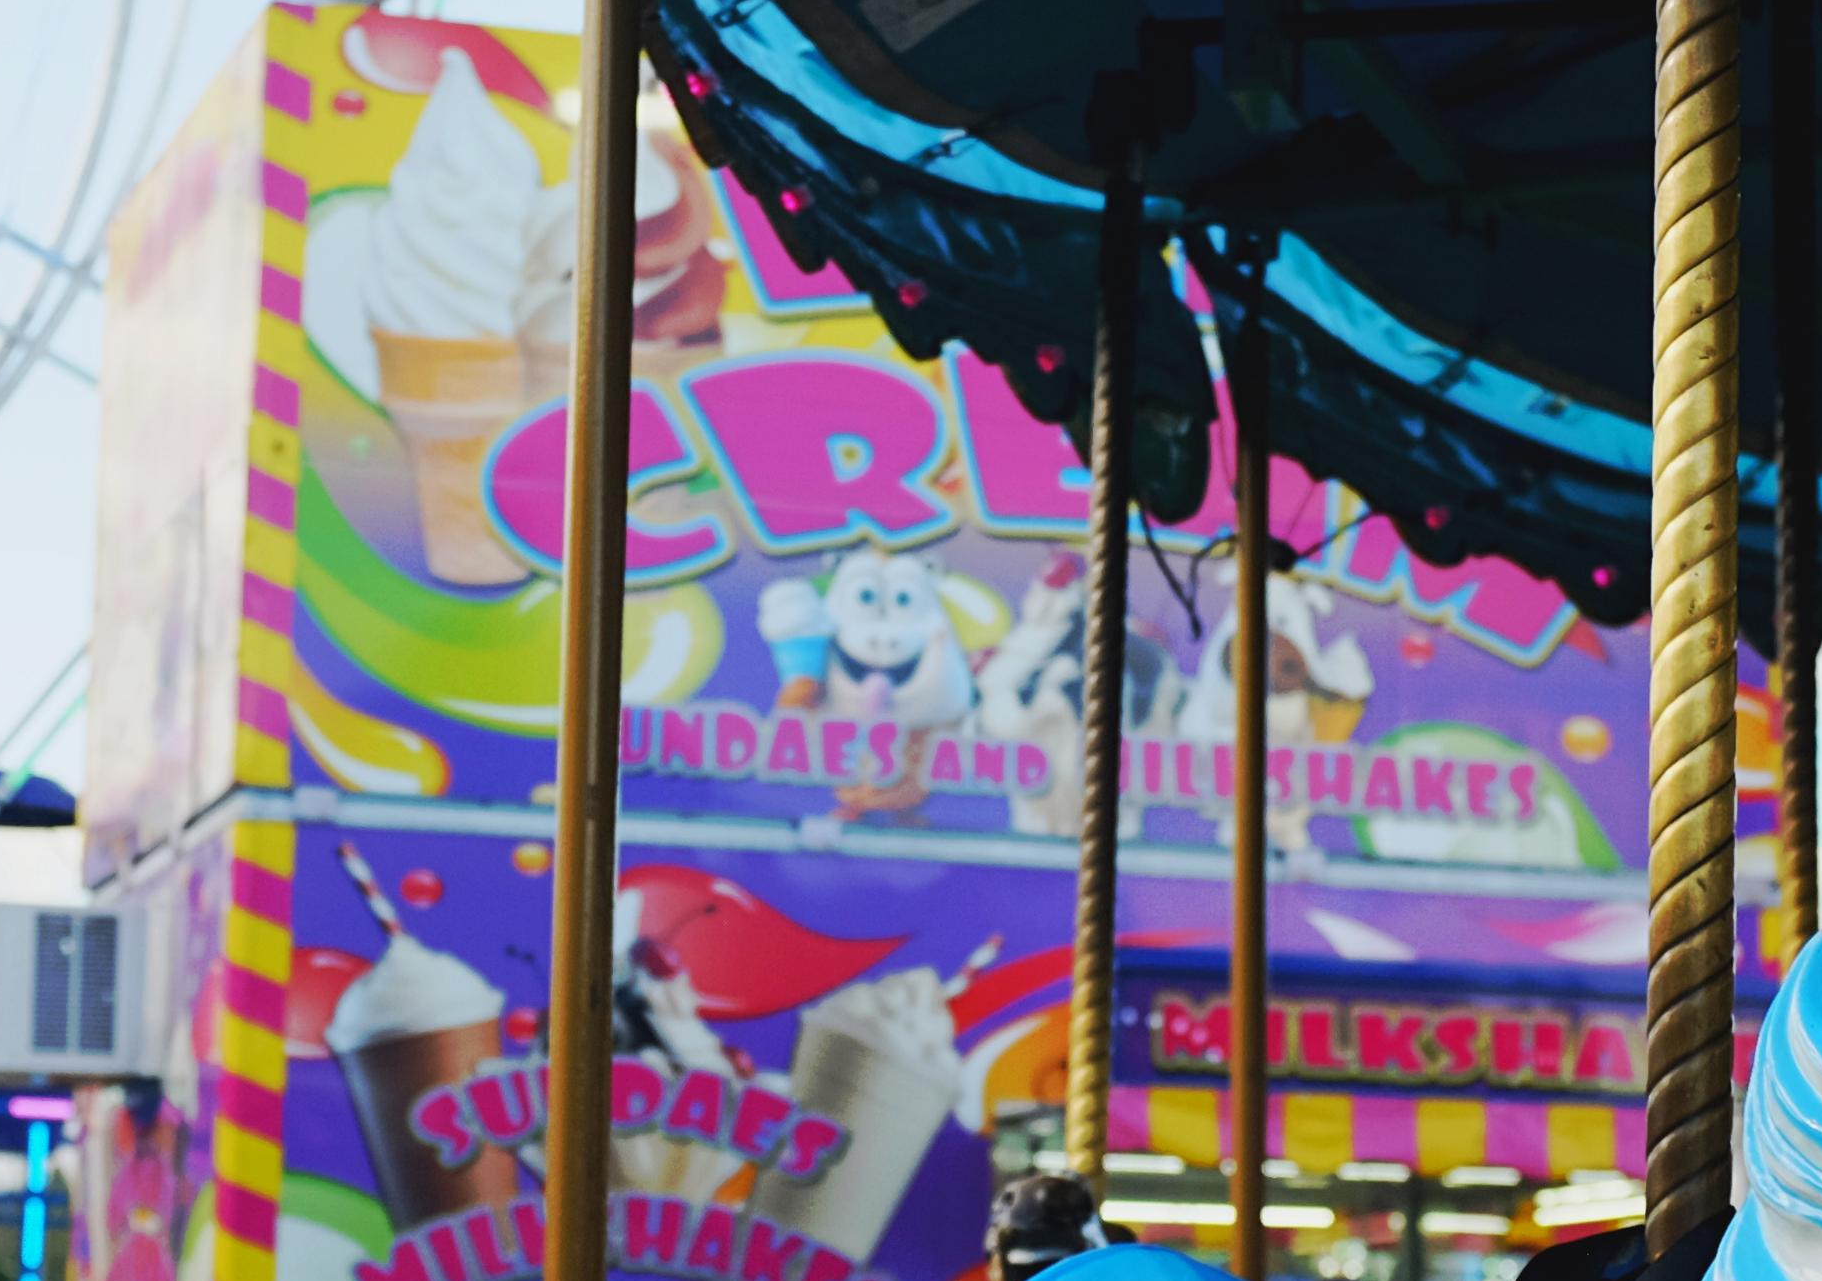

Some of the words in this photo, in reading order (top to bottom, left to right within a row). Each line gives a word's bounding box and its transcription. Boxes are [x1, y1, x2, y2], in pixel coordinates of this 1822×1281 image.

[618, 703, 902, 781] UNDAES
[927, 736, 1050, 790] AND
[1119, 735, 1537, 819] ILSHAKES
[414, 1058, 843, 1177] SUDAES
